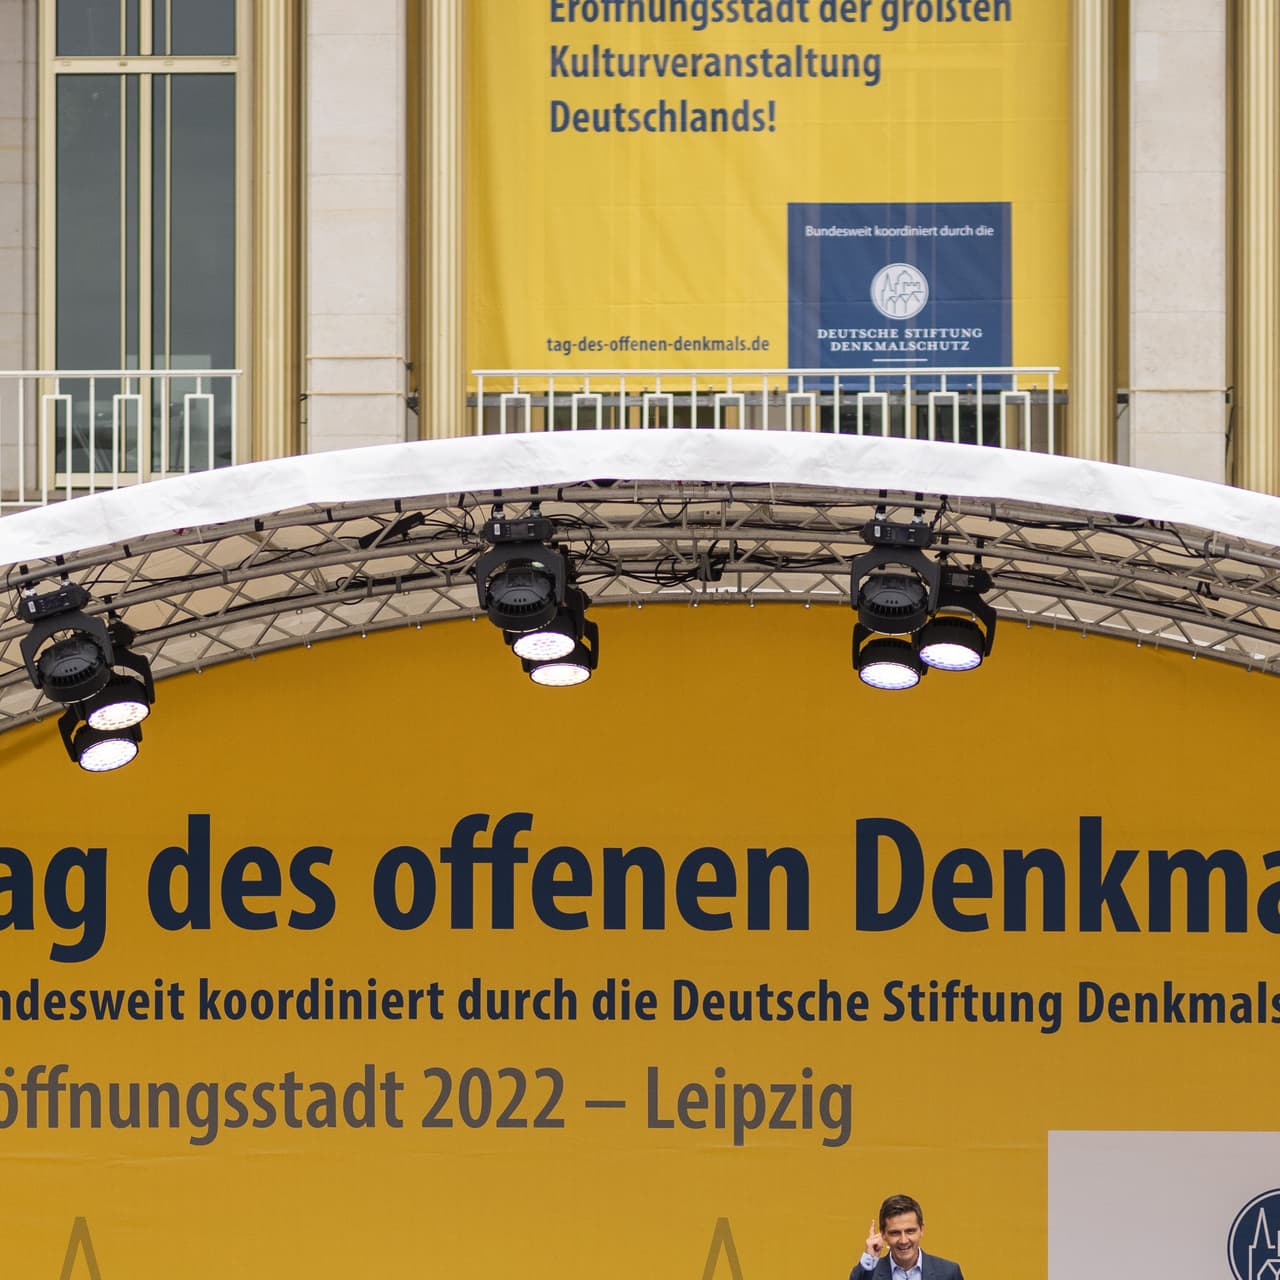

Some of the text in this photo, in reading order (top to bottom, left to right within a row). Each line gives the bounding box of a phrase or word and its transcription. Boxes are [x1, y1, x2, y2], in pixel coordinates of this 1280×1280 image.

[549, 44, 882, 87] Kulturveranstaltung
[549, 99, 776, 133] Deutschlands!
[805, 225, 995, 239] Bundesweit koordiniert durch die
[546, 335, 770, 356] tag-des-offenen-denkmals.de
[816, 328, 983, 339] DEUTSCHE STIFTUNG
[829, 341, 970, 352] DENKMALSCHUTZ
[147, 813, 337, 931] des
[373, 811, 810, 931] offenen
[198, 977, 445, 1022] koordiniert
[457, 978, 578, 1021] durch
[591, 978, 658, 1021] die
[673, 979, 869, 1022] Deutsche
[882, 979, 1064, 1035] Stiftung
[422, 1066, 566, 1130] 2022
[647, 1065, 853, 1148] Leipzig
